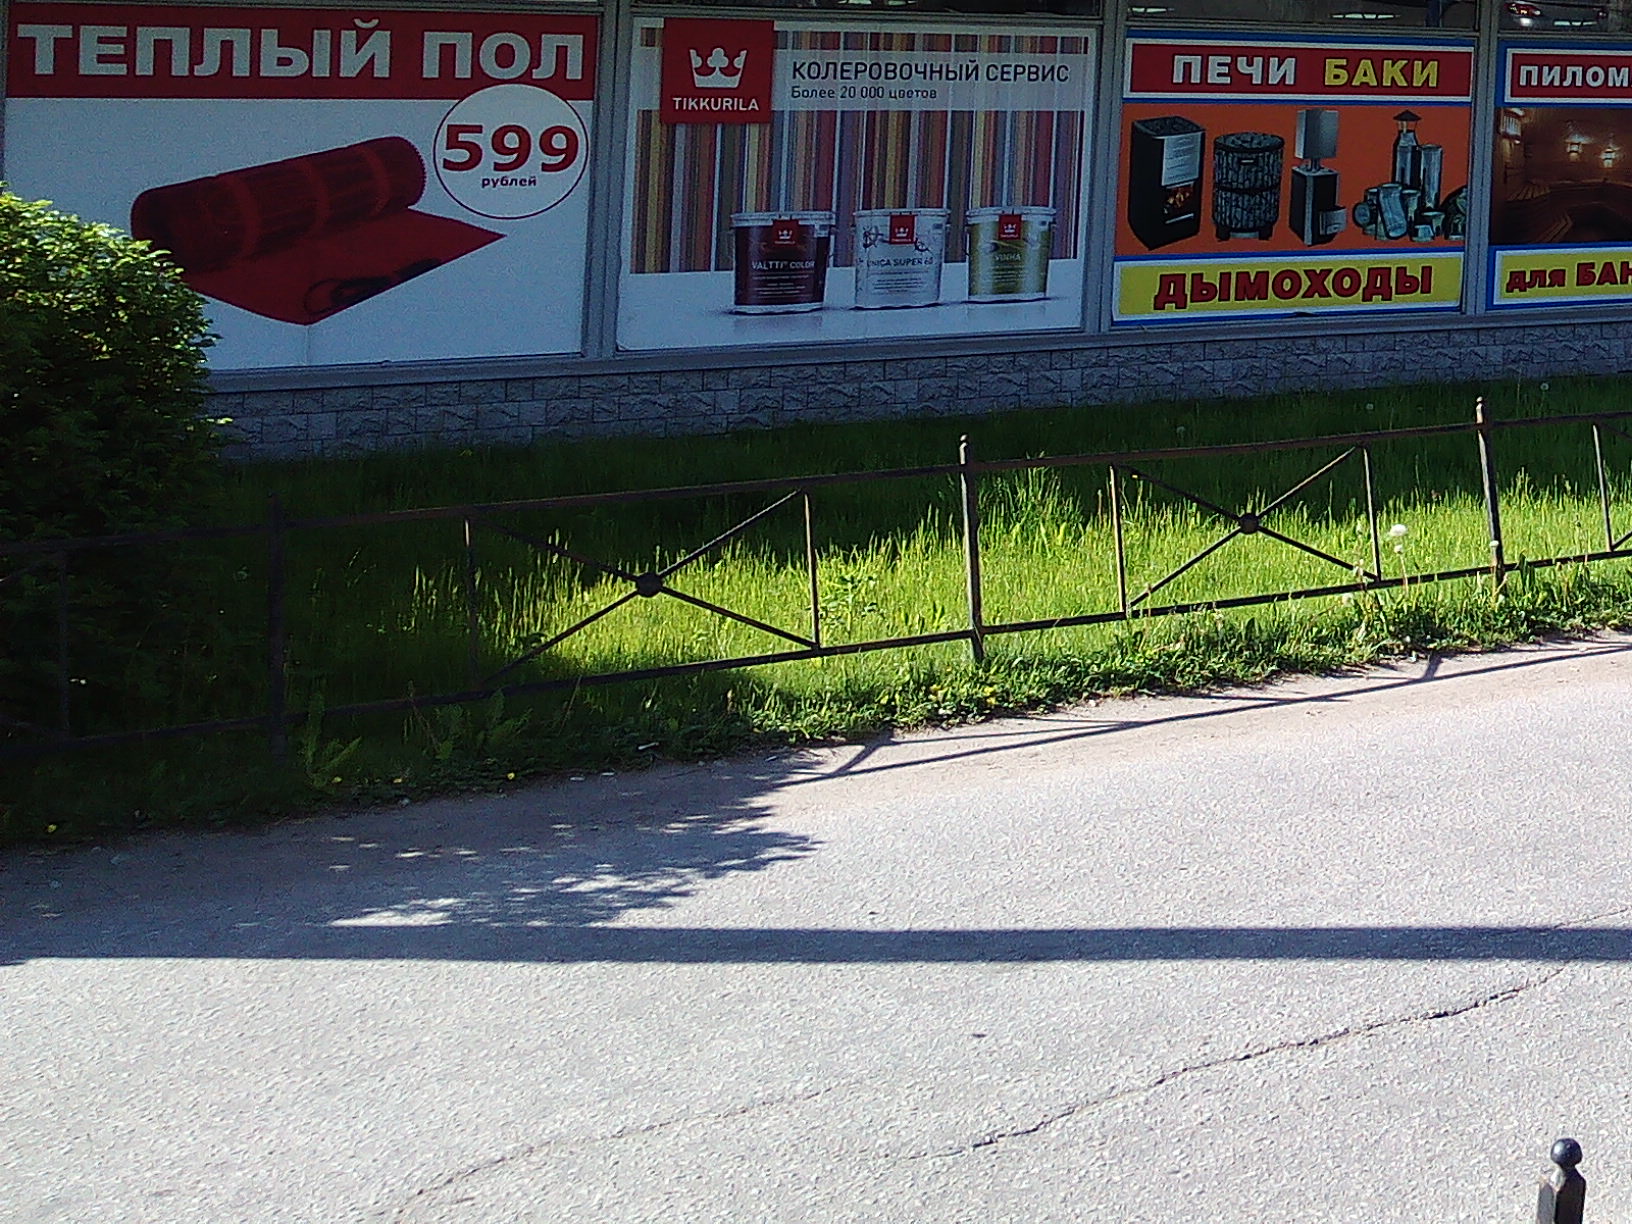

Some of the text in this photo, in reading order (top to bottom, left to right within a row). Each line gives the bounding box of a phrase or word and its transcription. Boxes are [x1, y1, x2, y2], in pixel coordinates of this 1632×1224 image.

[17, 18, 585, 81] ТЕПЛЫЙ ПОЛ
[792, 60, 1070, 82] КОЛЕРОВОЧНЫЙ СЕРВИС
[1172, 55, 1440, 88] ПЕЧИ БАКИ
[672, 97, 759, 111] TIKKURILA
[790, 86, 938, 101] Более 20 000 цветов
[442, 124, 580, 173] 599
[481, 174, 537, 190] рублей
[1153, 265, 1433, 311] ДЫМОХОДЫ
[1505, 271, 1567, 293] для
